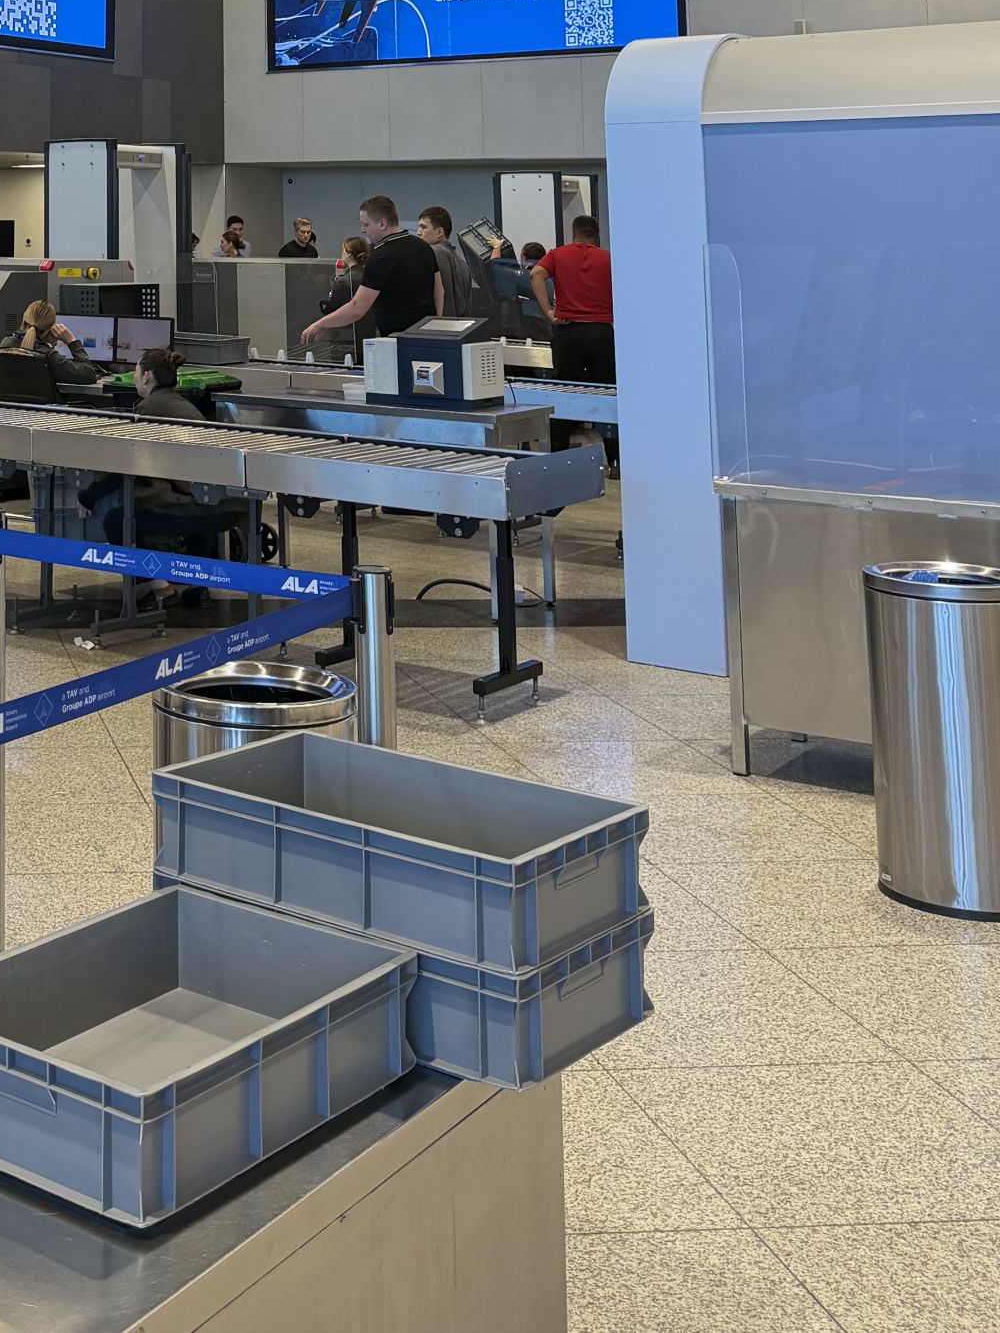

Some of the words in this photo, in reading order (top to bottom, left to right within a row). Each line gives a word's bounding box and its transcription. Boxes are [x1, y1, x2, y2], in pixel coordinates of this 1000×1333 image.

[80, 548, 113, 566] ALA
[176, 560, 188, 568] TAV
[189, 562, 201, 570] and
[170, 569, 194, 579] Groupe
[194, 572, 209, 580] ADP
[209, 574, 231, 584] airport
[280, 576, 319, 595] ALA
[154, 653, 183, 681] ALA
[66, 688, 78, 699] TAV
[79, 685, 90, 696] and
[61, 702, 83, 714] Groupe
[84, 694, 97, 705] ADP
[97, 689, 116, 701] airport
